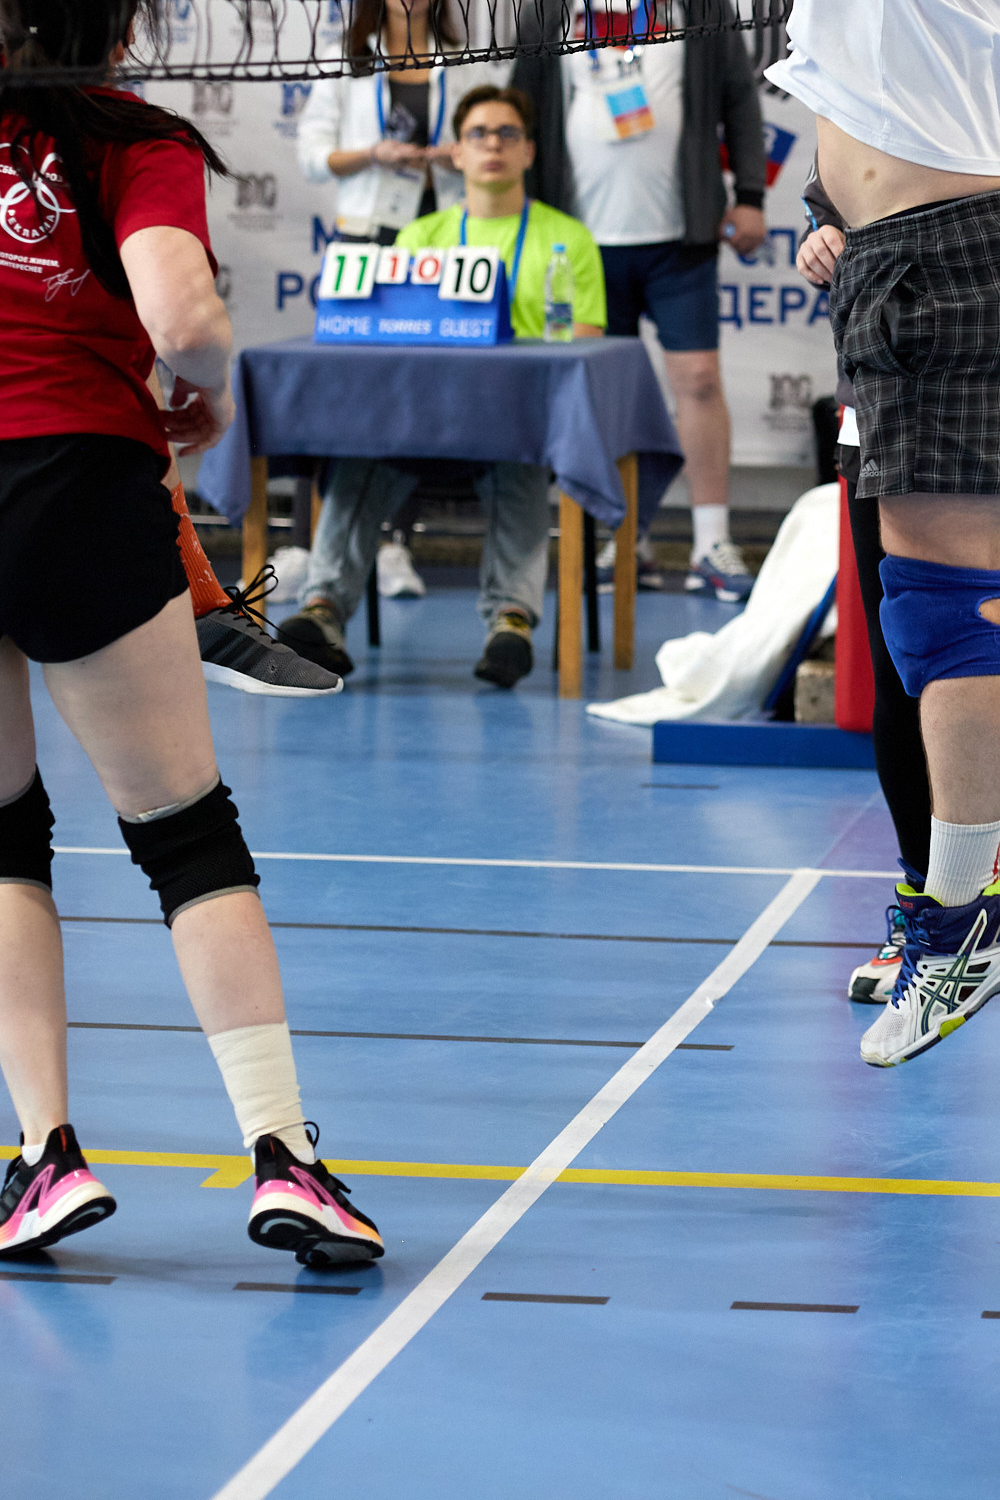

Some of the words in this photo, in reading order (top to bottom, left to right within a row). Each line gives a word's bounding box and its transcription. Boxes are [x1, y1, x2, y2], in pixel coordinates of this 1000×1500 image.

[0, 251, 28, 263] ОТОРОЕ
[334, 255, 369, 292] 11
[455, 257, 492, 293] 10
[718, 285, 830, 329] ДЕРА
[317, 316, 371, 335] HOME
[378, 319, 432, 334] TORRES
[439, 317, 492, 337] GUEST
